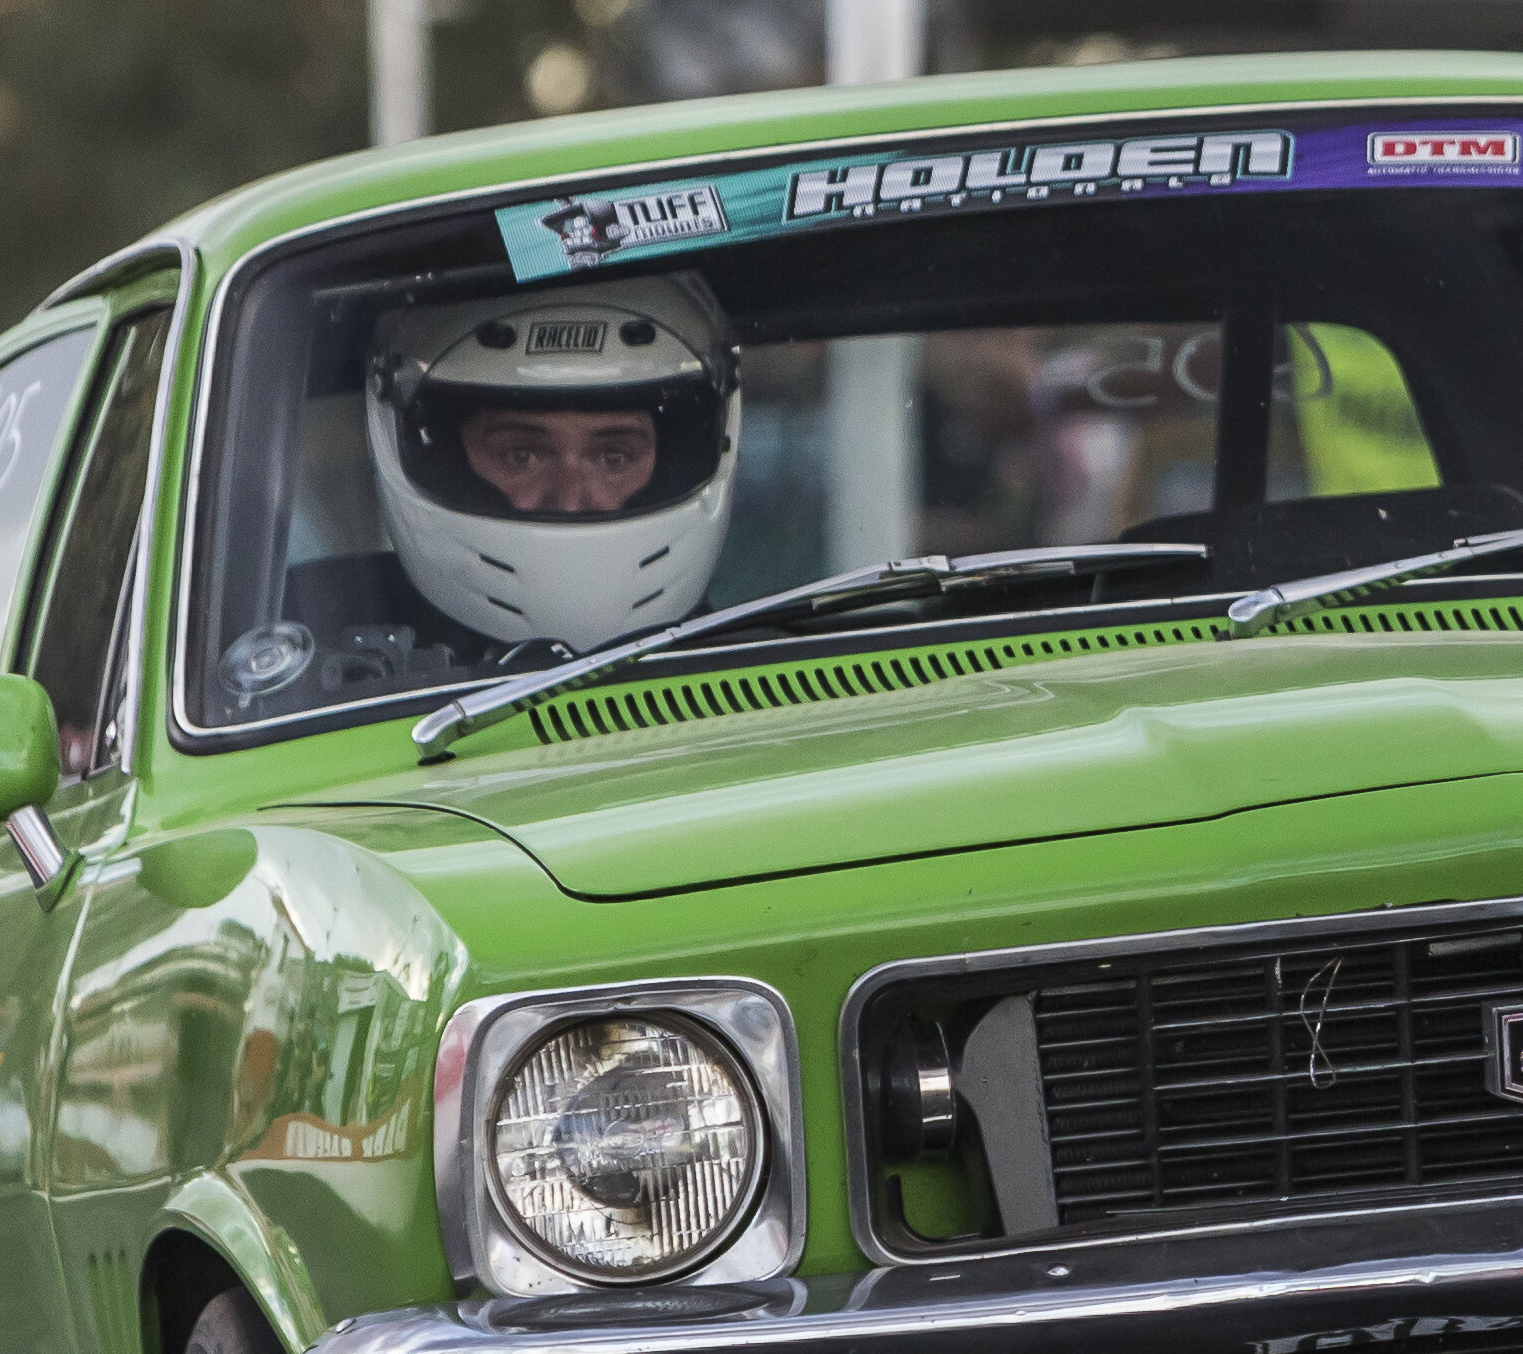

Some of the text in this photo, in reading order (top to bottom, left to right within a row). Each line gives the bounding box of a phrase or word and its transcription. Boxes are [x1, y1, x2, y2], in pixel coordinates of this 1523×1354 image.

[1382, 137, 1507, 157] DTM
[786, 131, 1293, 219] HOLDEN
[619, 190, 708, 227] TUFF
